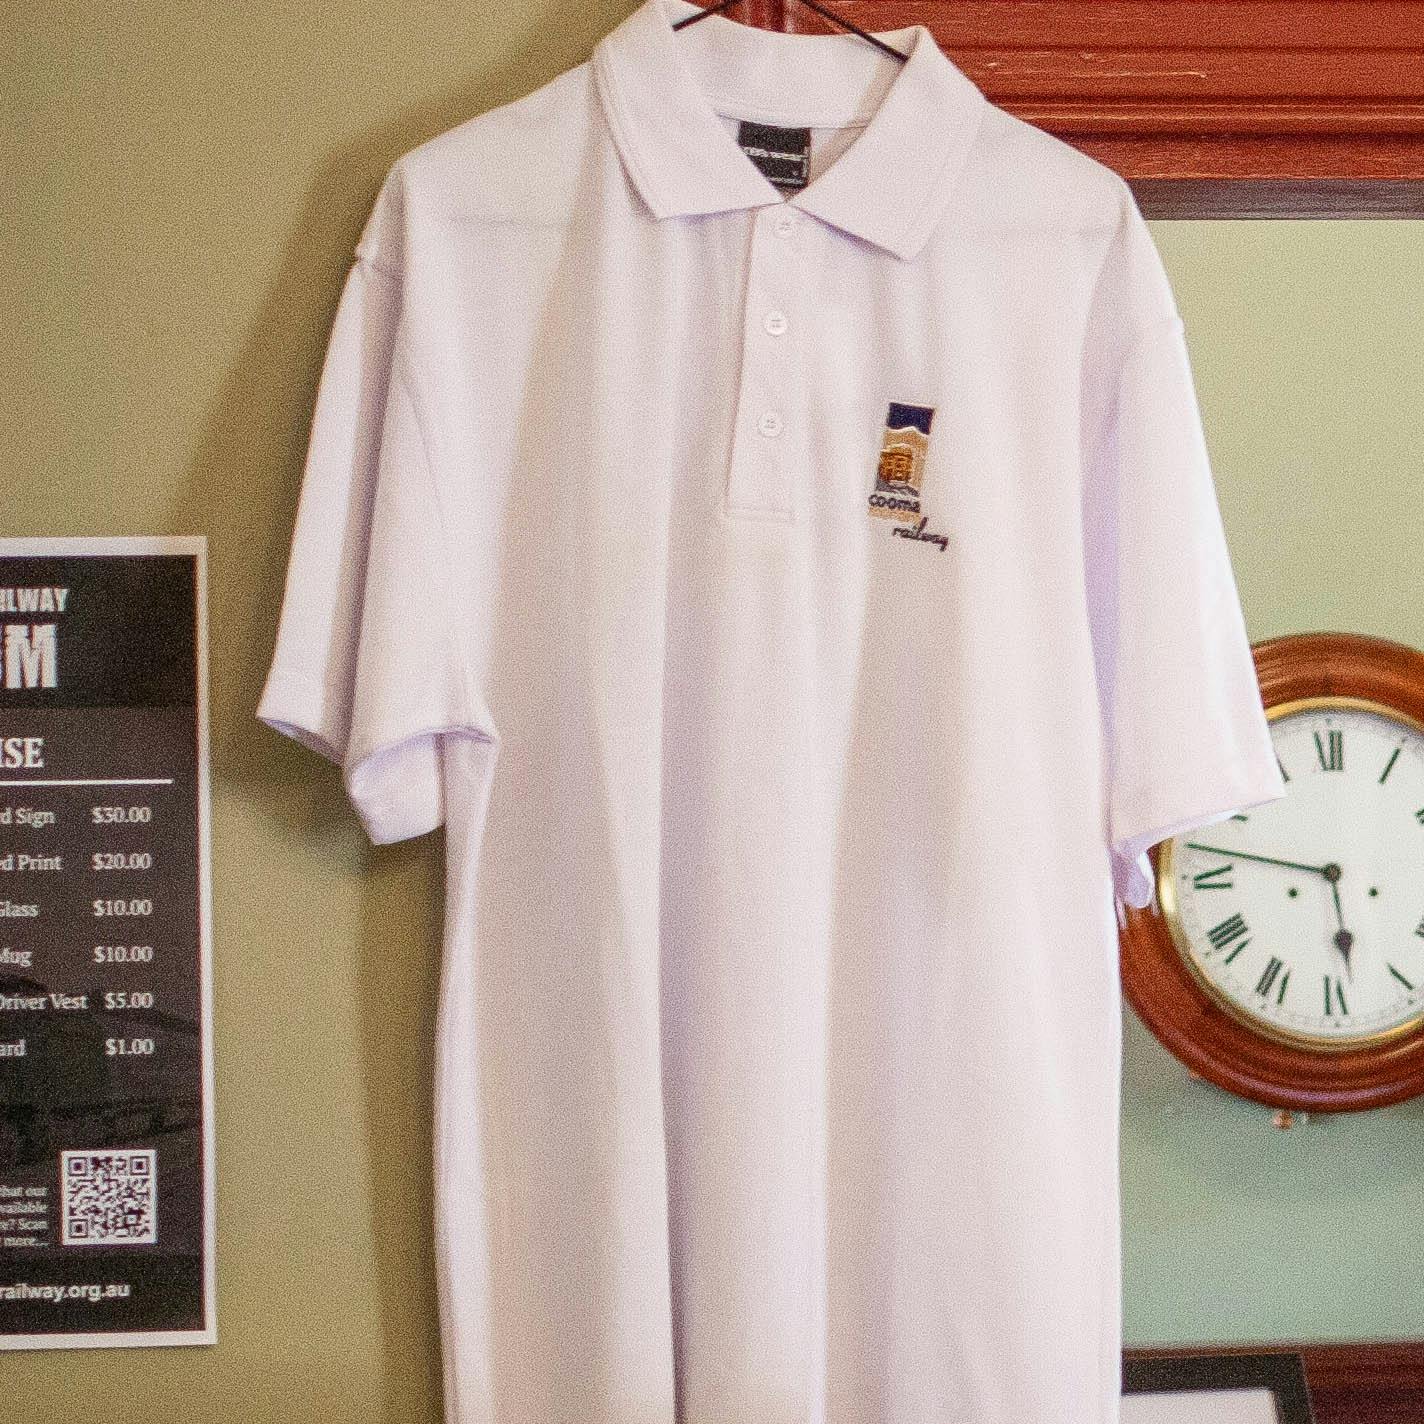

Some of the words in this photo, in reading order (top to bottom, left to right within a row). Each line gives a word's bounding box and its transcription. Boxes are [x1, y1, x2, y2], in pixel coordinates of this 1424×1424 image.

[15, 807, 55, 829] Sign
[92, 806, 152, 824] $30.00
[17, 854, 63, 871] Print
[92, 853, 152, 871] $20.00
[93, 900, 152, 917] $10.00
[94, 946, 154, 963] $10.00
[49, 993, 89, 1010] Vest
[104, 992, 154, 1009] $5.00
[105, 1038, 155, 1056] $1.00
